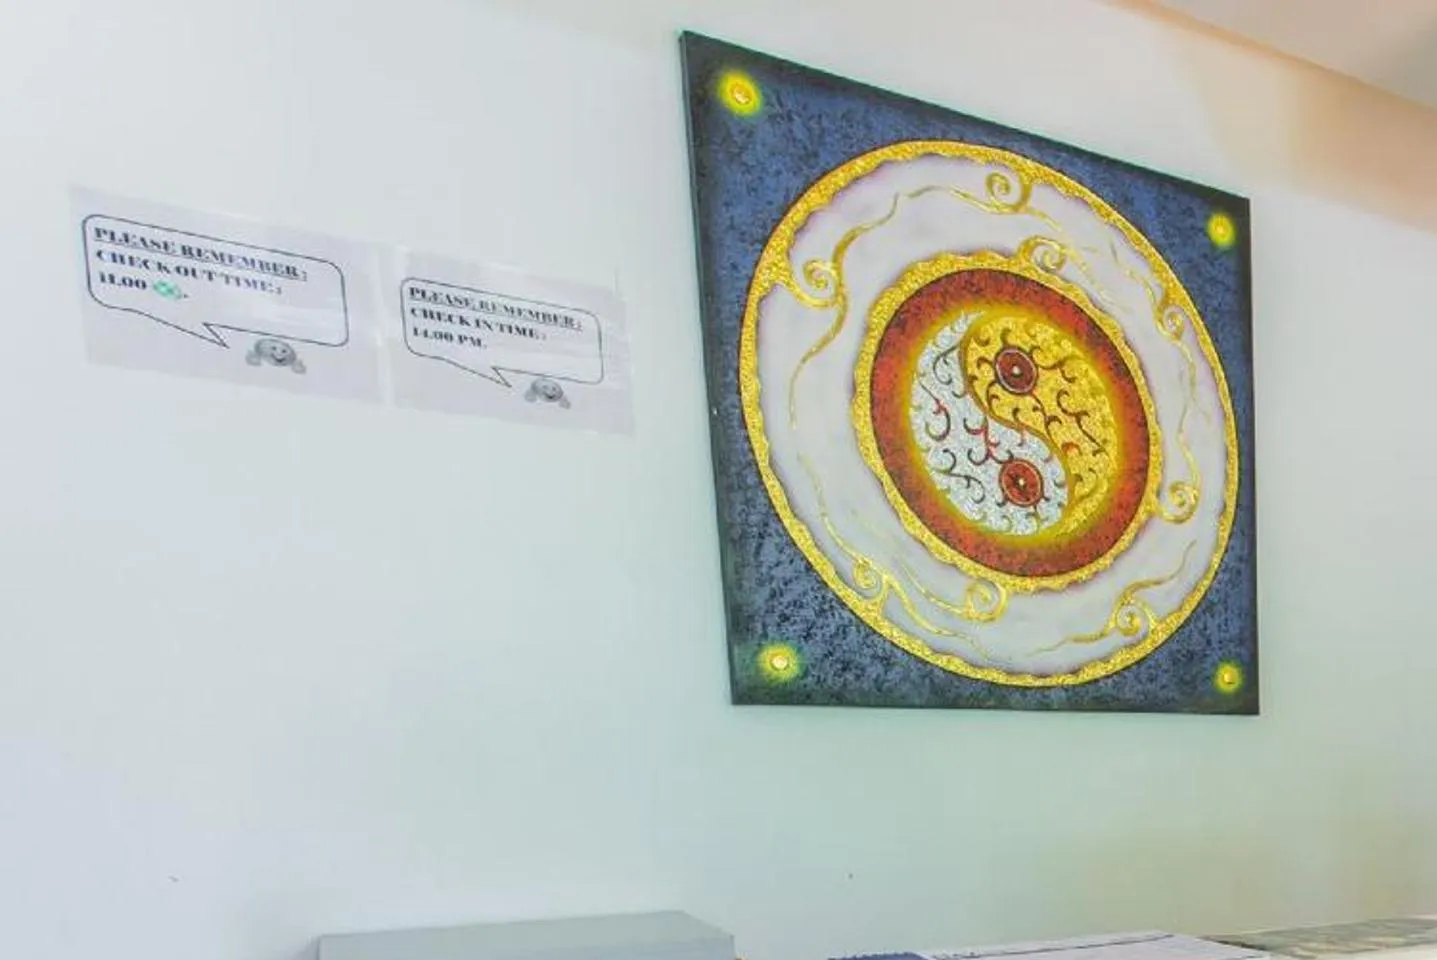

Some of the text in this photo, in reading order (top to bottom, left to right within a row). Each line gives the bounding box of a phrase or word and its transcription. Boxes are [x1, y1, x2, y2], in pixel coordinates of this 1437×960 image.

[94, 227, 176, 255] PLEASE
[96, 249, 171, 275] CHECK
[175, 265, 218, 282] OUT
[408, 287, 474, 308] PLEASE
[410, 308, 471, 327] CHECK
[474, 317, 494, 332] IN
